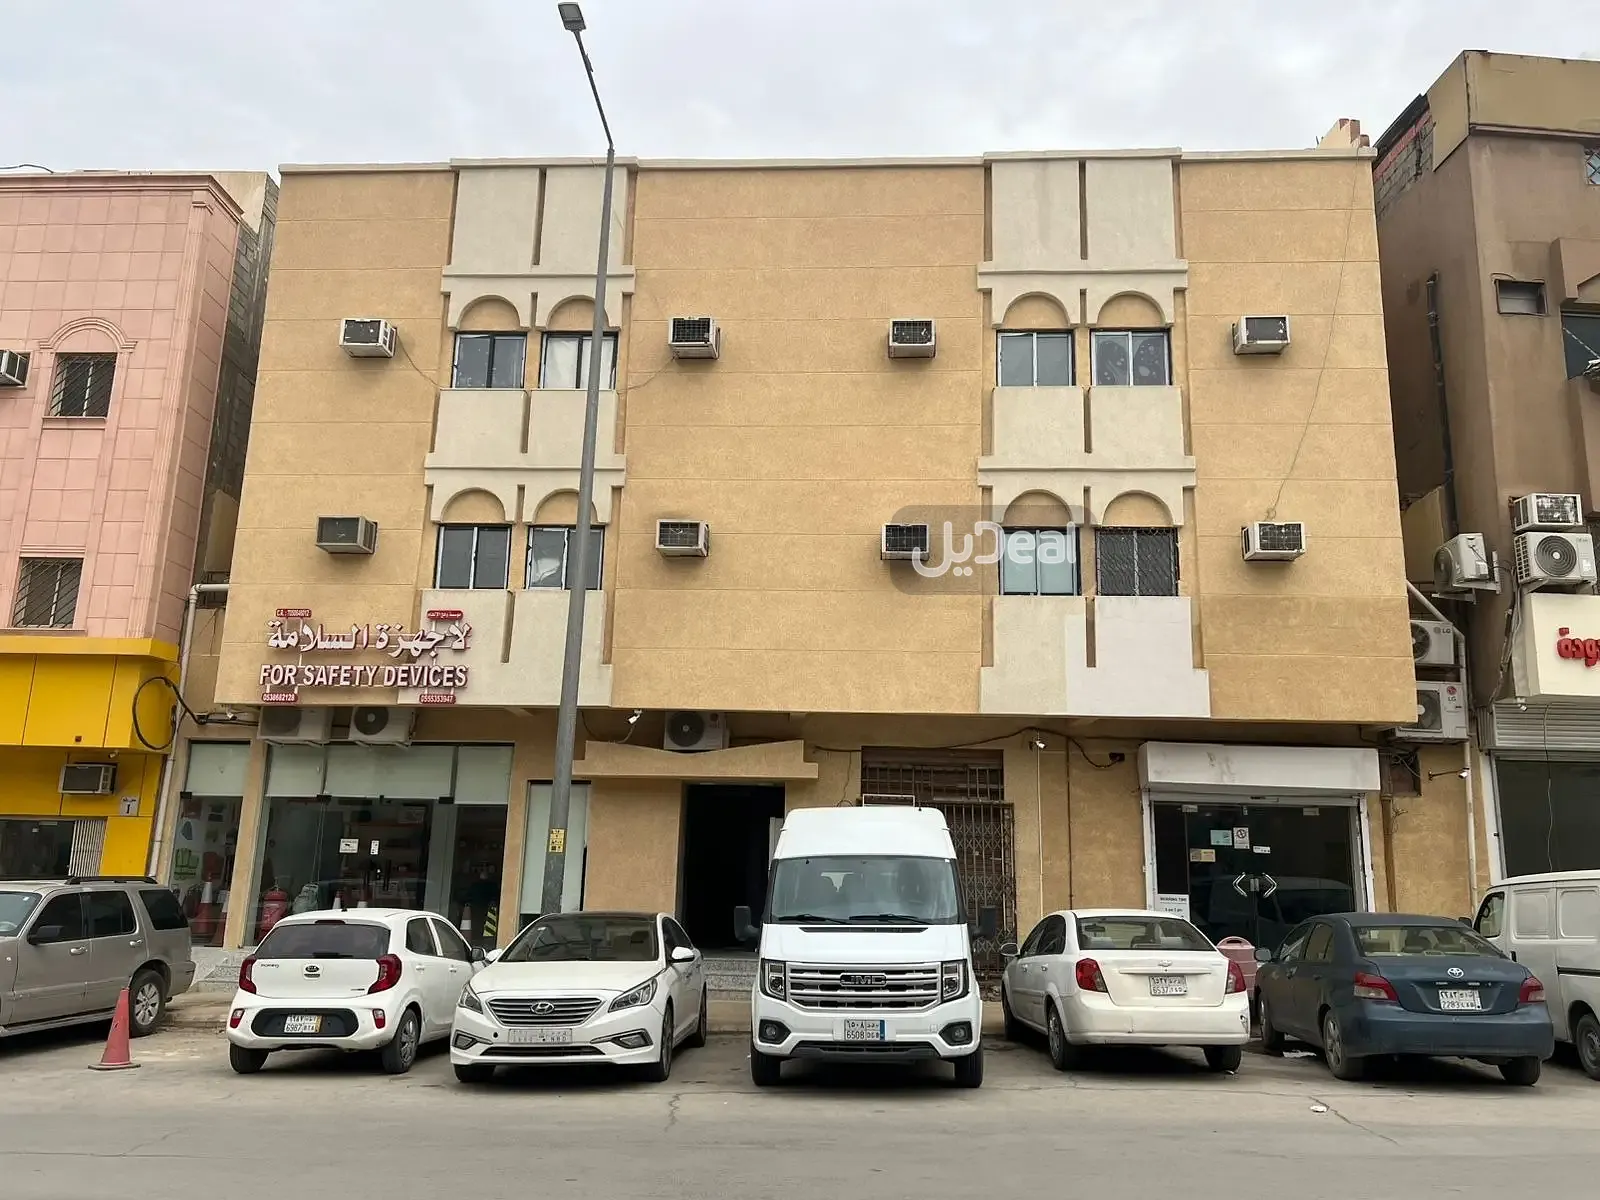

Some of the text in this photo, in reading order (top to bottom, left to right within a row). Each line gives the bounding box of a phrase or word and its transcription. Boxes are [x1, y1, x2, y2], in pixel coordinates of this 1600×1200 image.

[267, 620, 370, 652] السلامة
[260, 664, 468, 688] FOR SAFETY DEVICES
[846, 1031, 865, 1039] 6508
